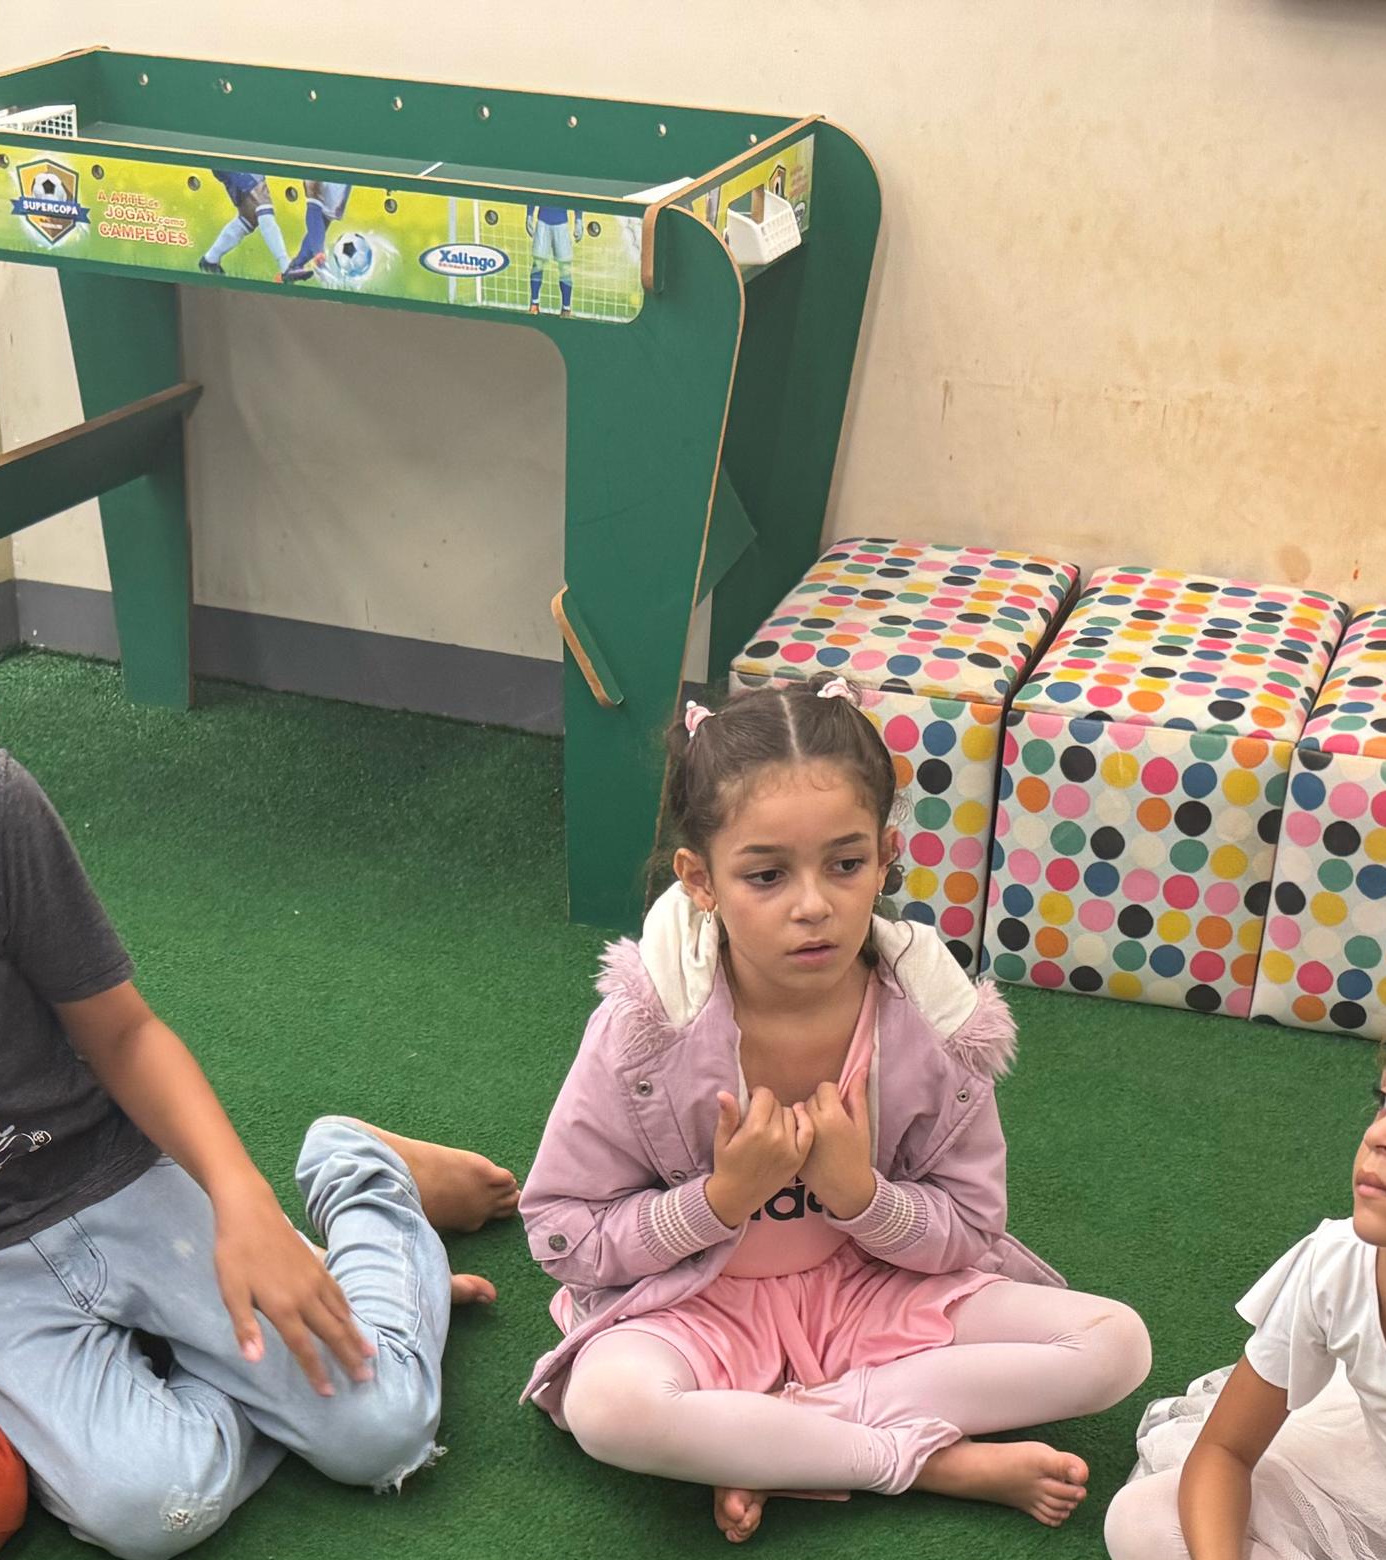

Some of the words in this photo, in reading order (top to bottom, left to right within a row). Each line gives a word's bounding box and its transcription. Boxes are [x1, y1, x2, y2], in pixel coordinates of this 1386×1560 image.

[22, 199, 79, 216] SUPERCOPA
[110, 191, 147, 208] ARTE
[104, 204, 157, 223] JOGAR
[438, 249, 497, 272] Xalingo
